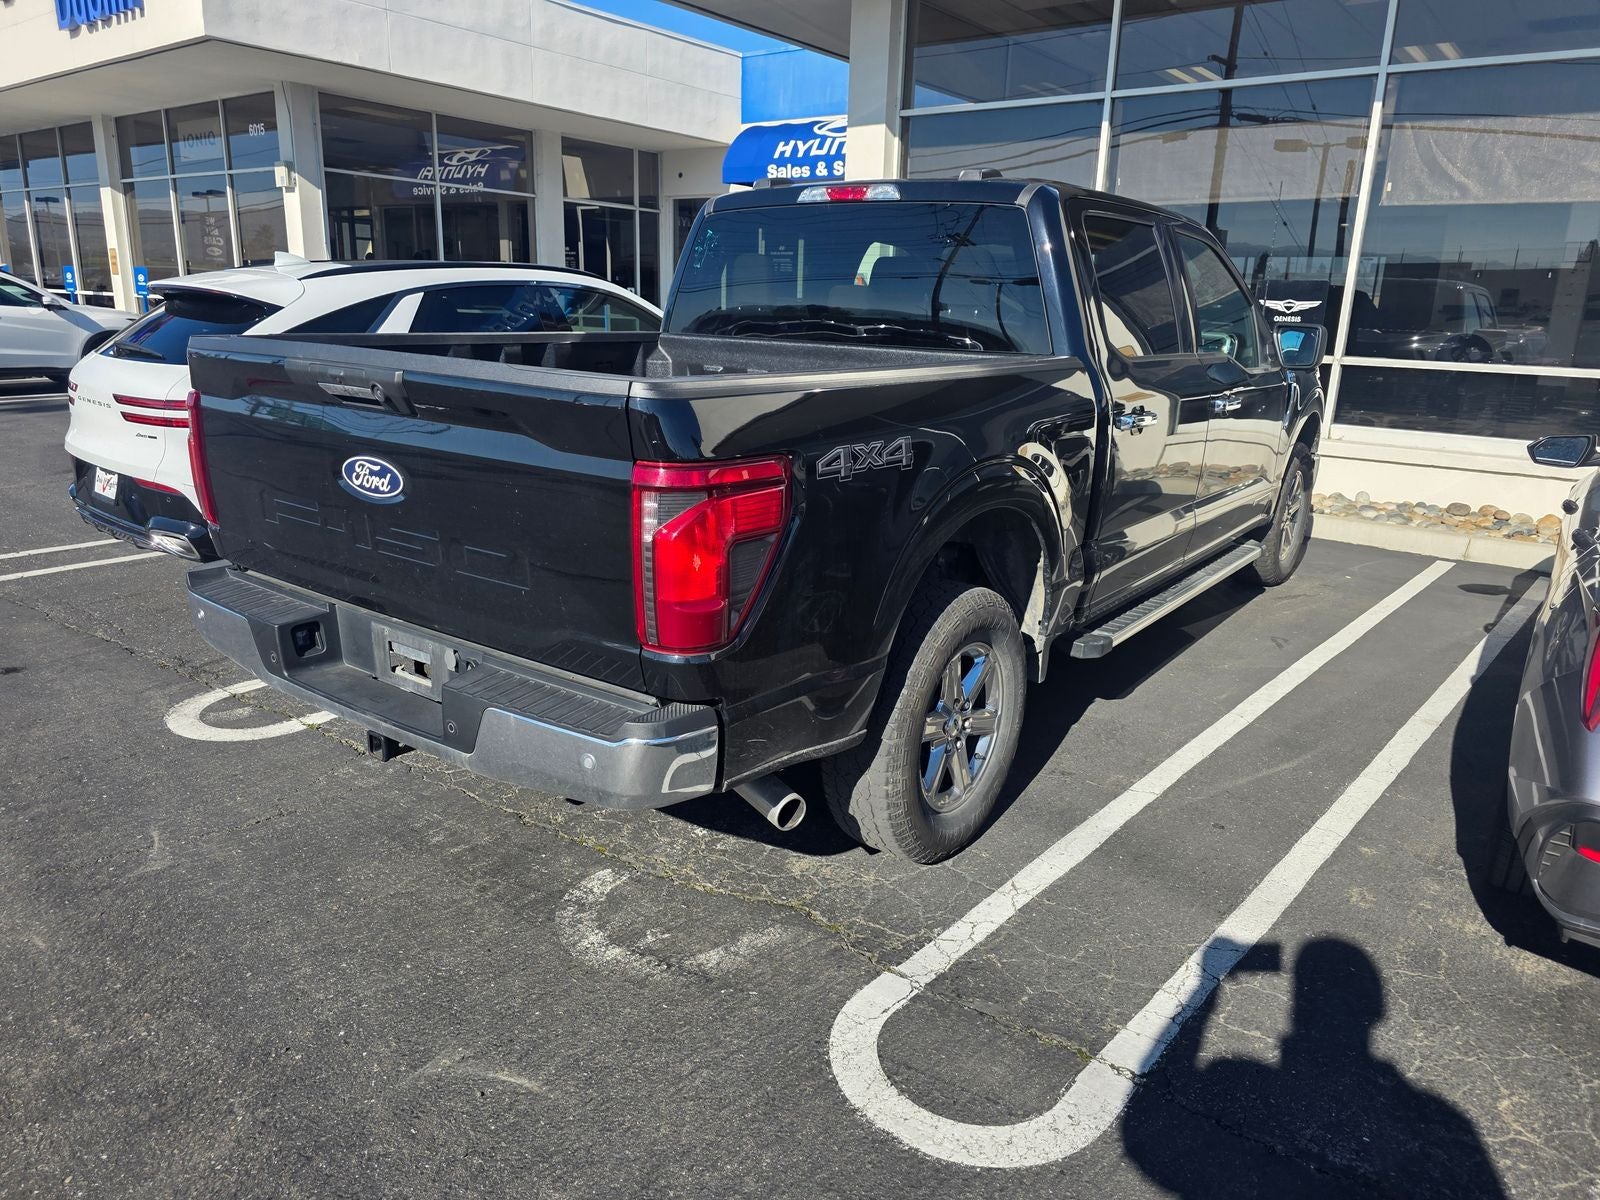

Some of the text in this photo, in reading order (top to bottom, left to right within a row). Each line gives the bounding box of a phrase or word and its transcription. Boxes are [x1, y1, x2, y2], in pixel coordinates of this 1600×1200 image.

[249, 123, 265, 136] 6015
[767, 163, 810, 178] Sales
[815, 160, 829, 176] &
[1273, 315, 1302, 323] GENESIS
[77, 395, 112, 409] GENESIS
[352, 460, 391, 492] Ford
